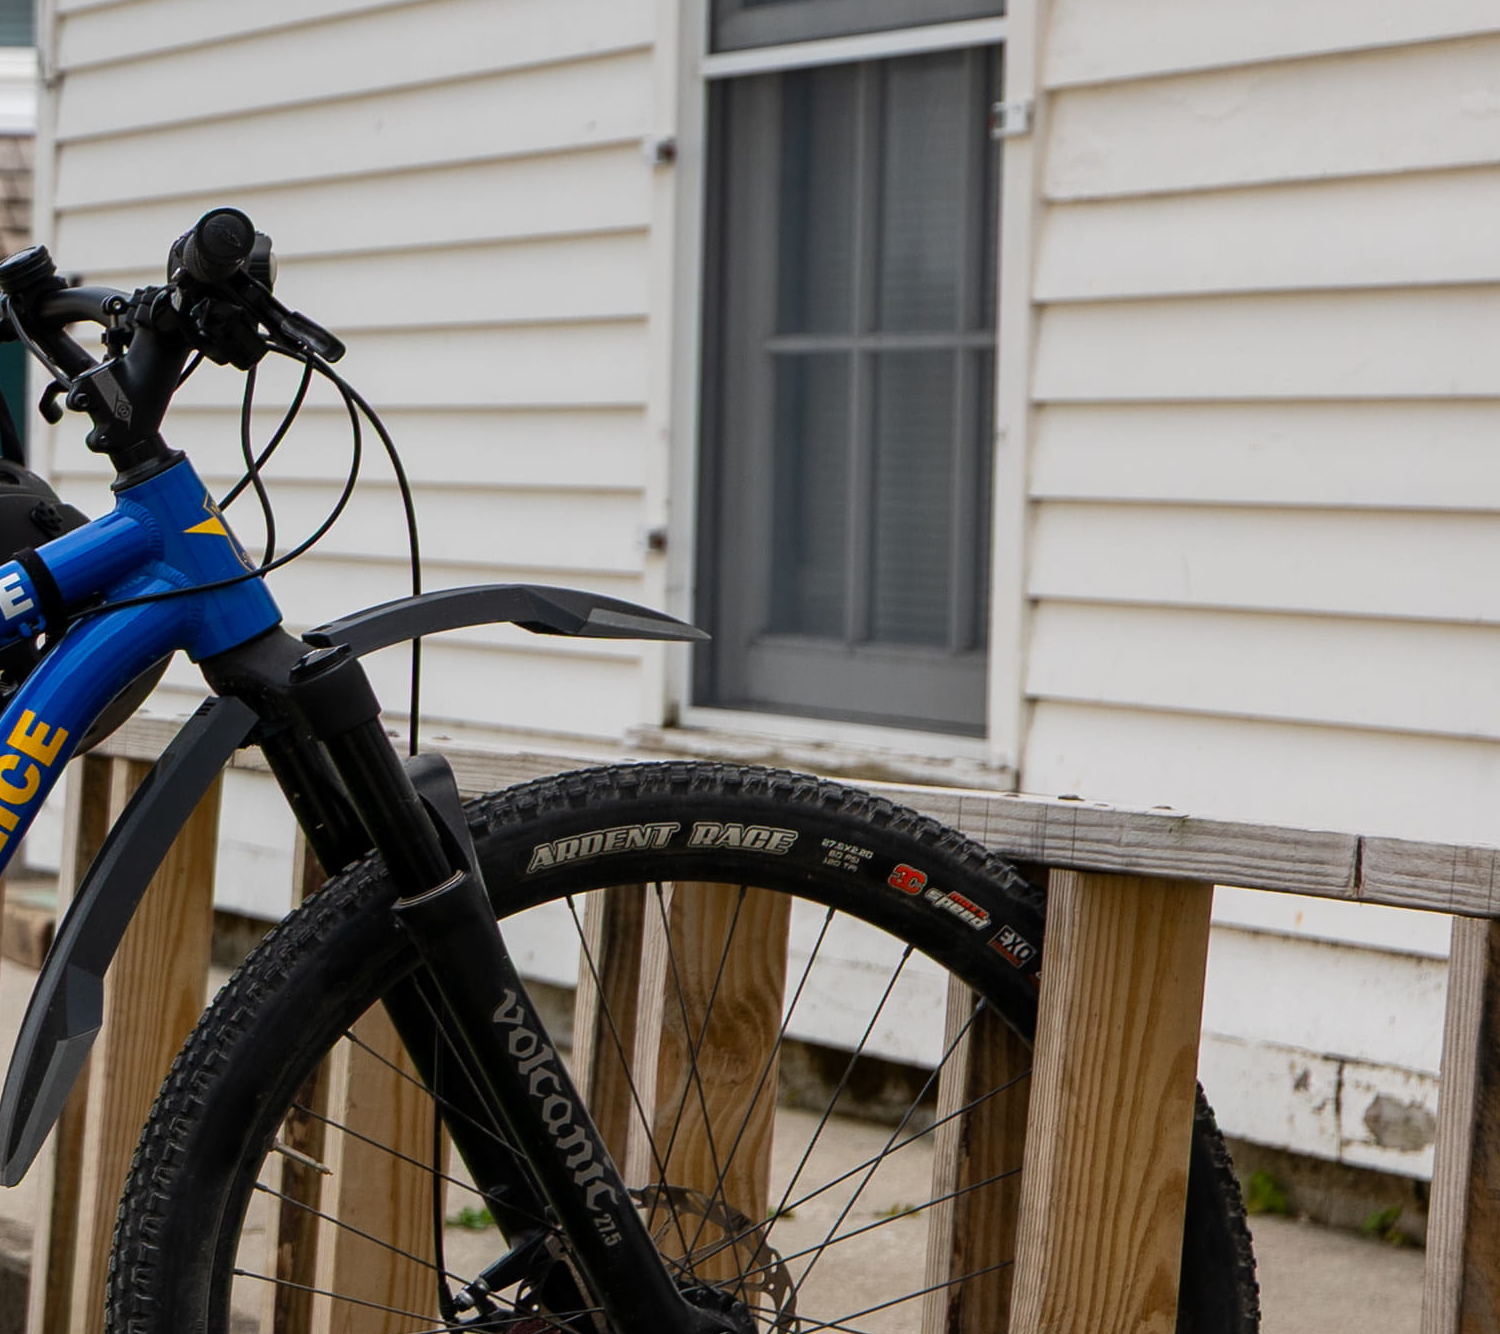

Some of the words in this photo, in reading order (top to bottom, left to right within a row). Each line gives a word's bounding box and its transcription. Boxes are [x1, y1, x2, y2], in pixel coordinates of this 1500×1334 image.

[526, 822, 681, 874] ARDENT
[687, 822, 799, 855] RACE
[924, 887, 992, 931] speed
[999, 926, 1036, 962] EXO
[493, 988, 620, 1212] volcanic
[593, 1213, 621, 1247] 27.5
